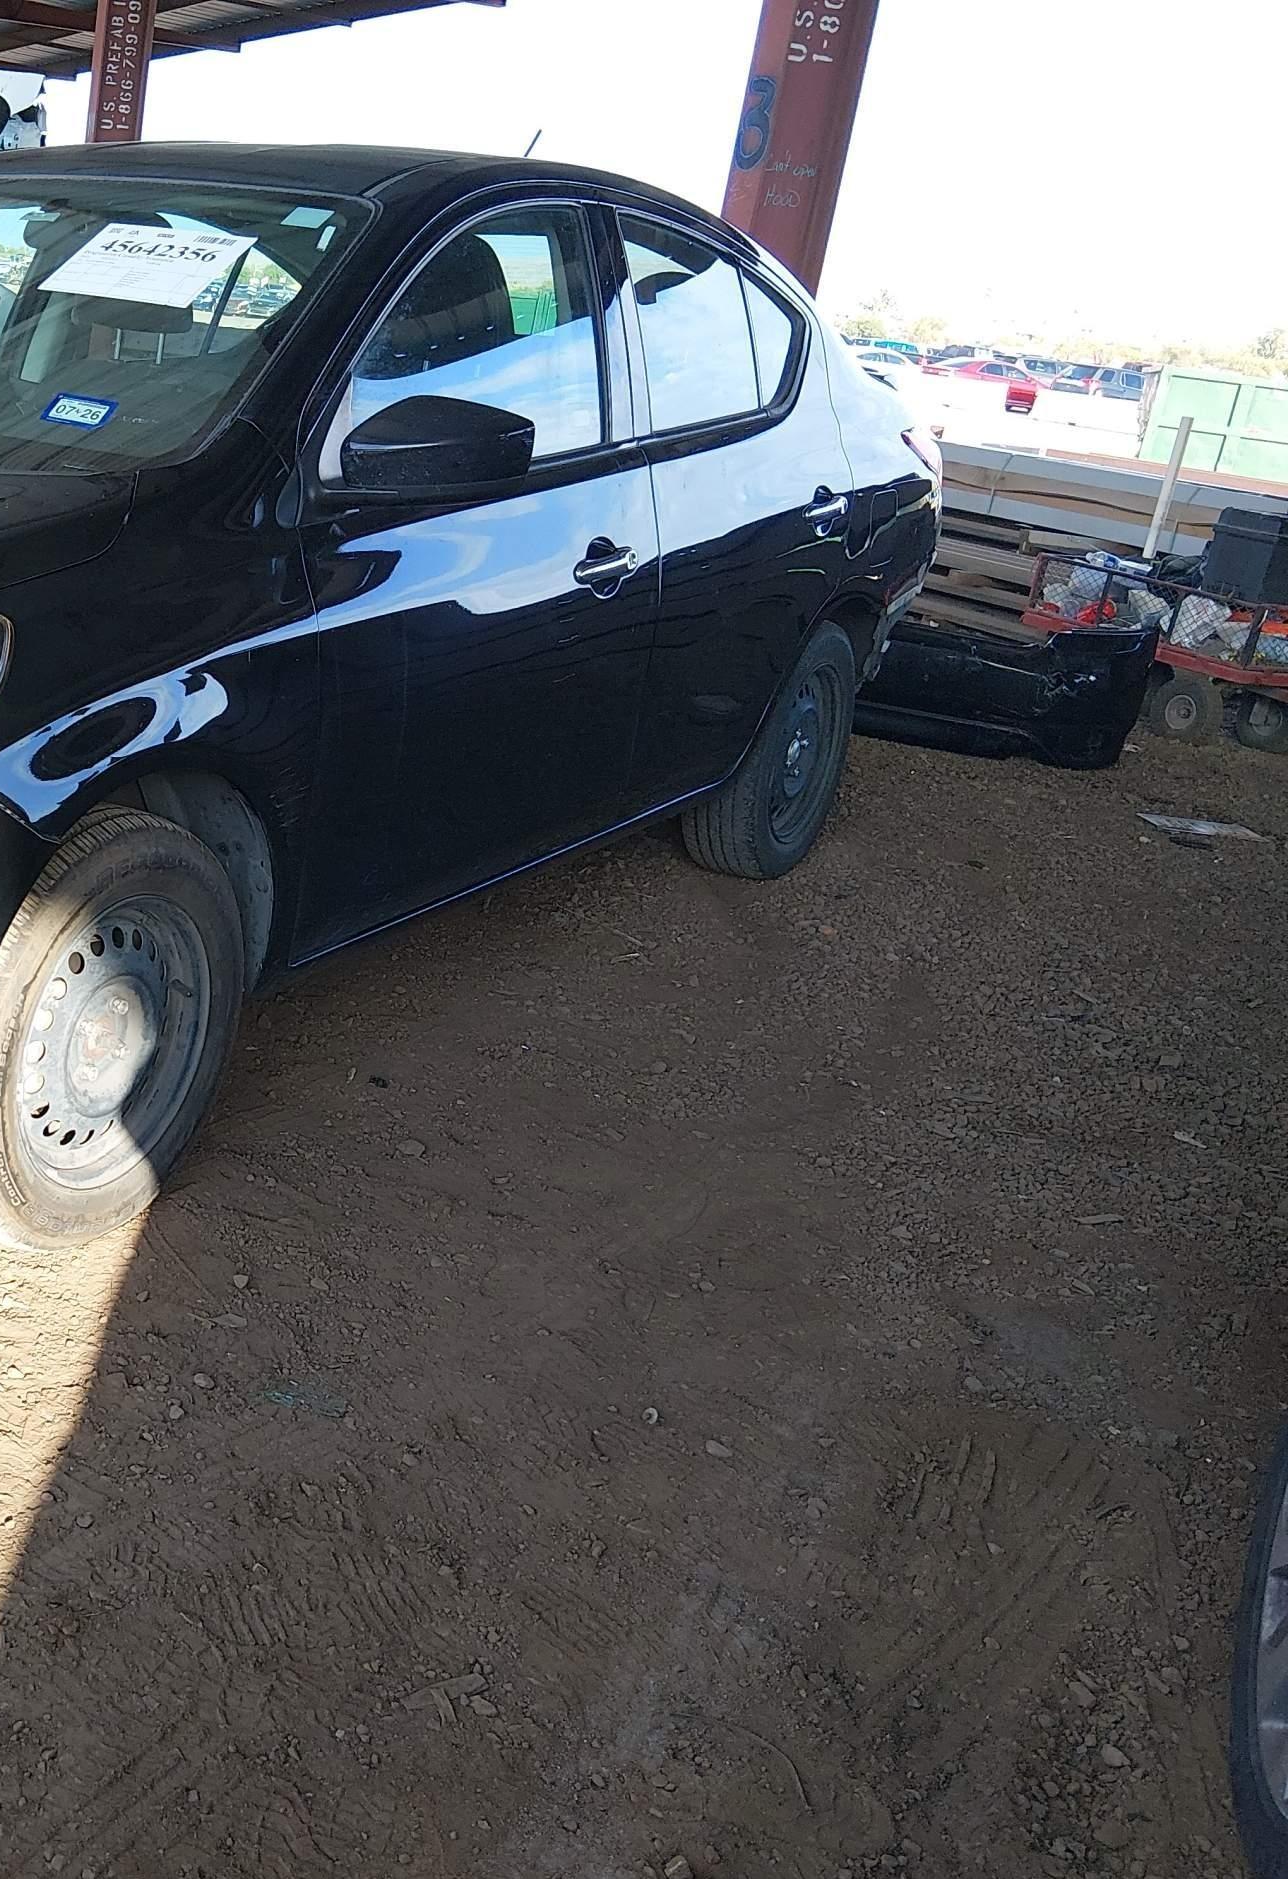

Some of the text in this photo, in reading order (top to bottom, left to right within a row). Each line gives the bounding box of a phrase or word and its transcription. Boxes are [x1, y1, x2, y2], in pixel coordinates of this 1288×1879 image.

[105, 16, 125, 86] PREFAB
[100, 239, 222, 263] 45642356
[55, 404, 77, 415] 07
[80, 408, 102, 420] 26
